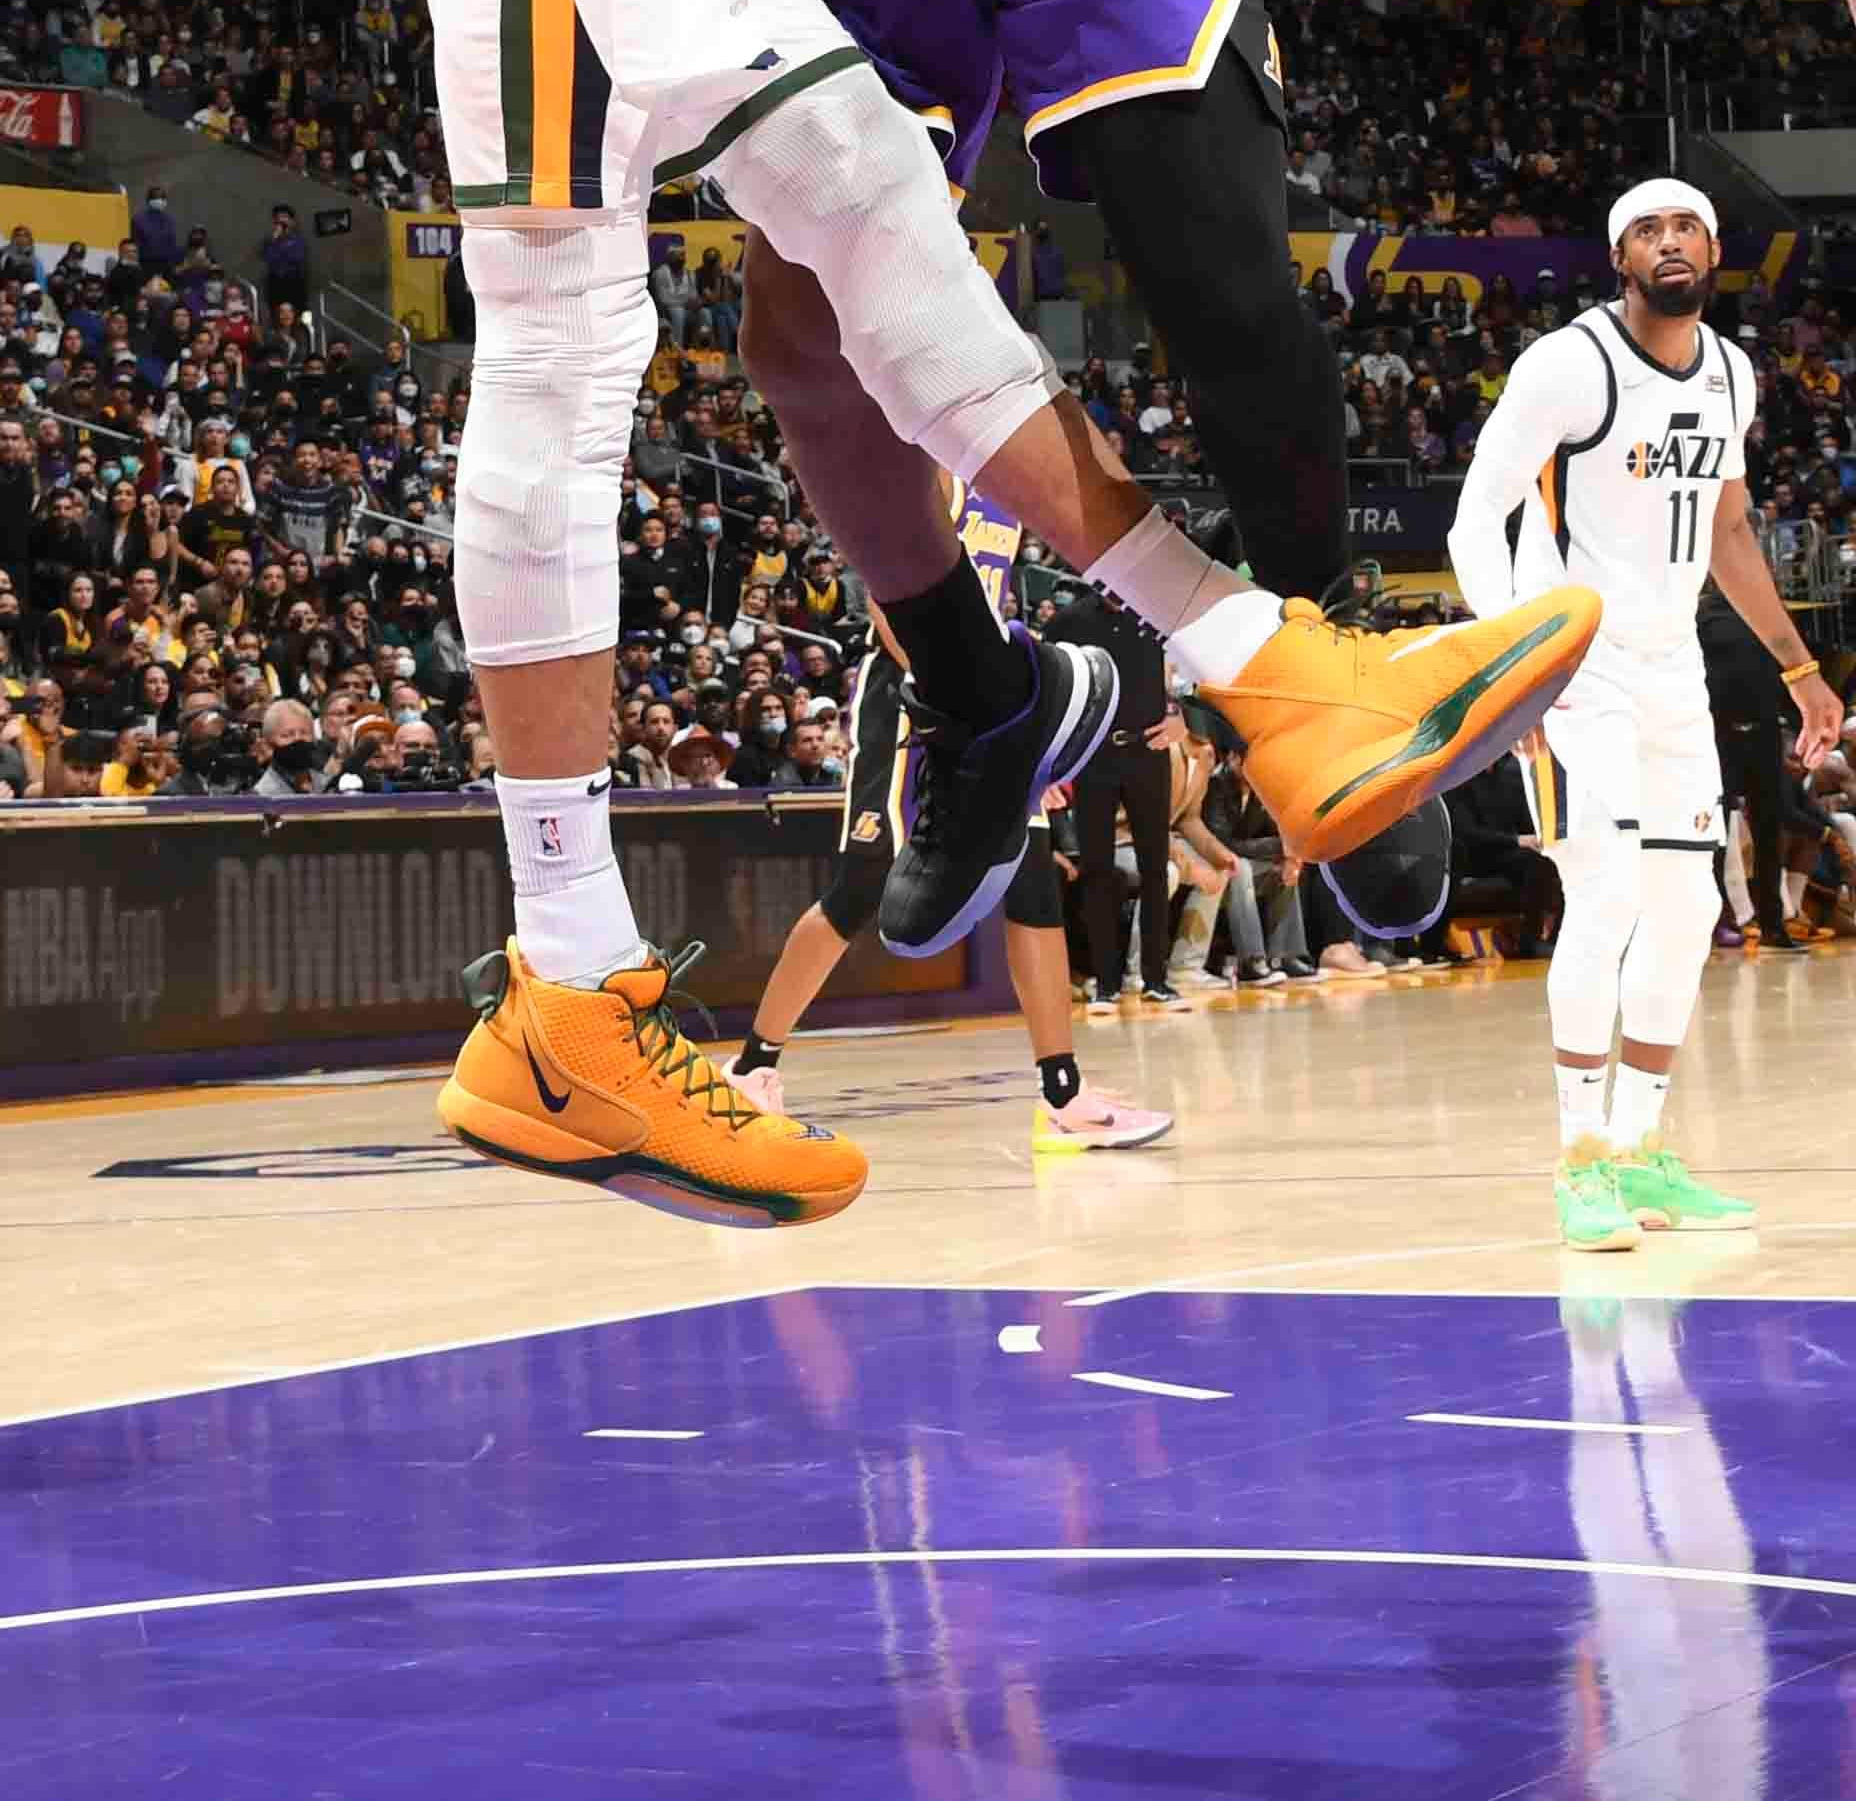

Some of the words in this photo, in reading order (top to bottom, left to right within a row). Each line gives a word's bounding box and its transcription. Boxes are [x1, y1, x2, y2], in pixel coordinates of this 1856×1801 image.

[415, 225, 453, 255] 104
[1345, 506, 1405, 535] TRA
[1668, 490, 1698, 564] 11
[1, 885, 89, 1009] NBA
